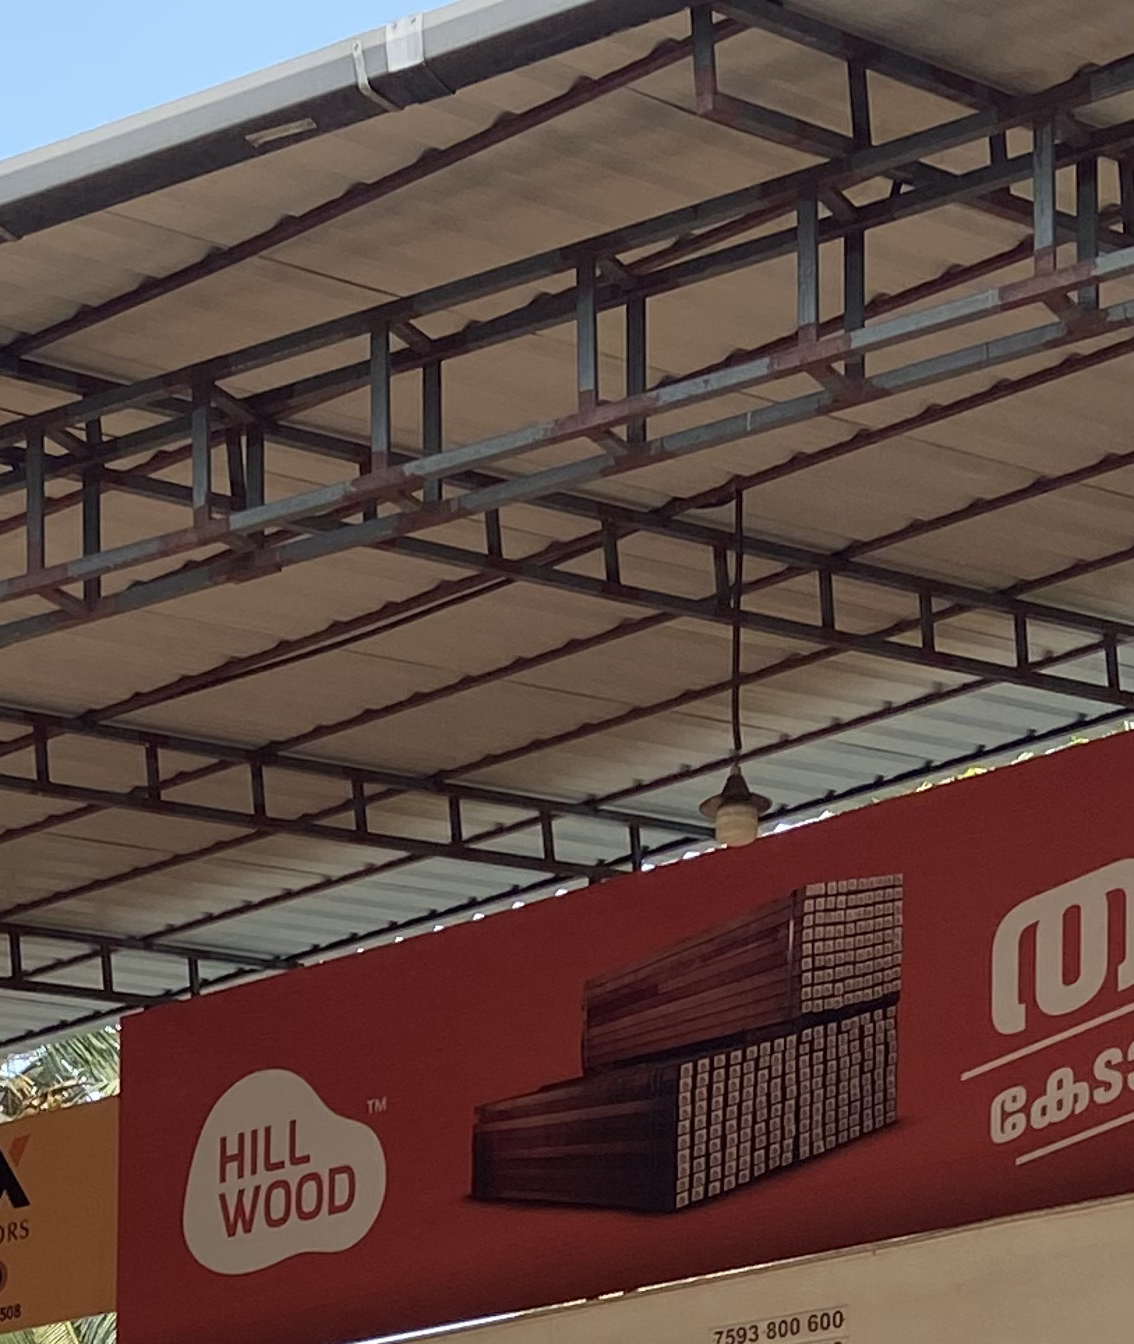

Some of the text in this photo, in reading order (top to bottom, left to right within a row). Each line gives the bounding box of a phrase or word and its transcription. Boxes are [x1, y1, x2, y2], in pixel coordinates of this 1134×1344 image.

[219, 1119, 310, 1183] HILL
[219, 1165, 356, 1238] WOOD
[766, 1317, 800, 1340] 800
[807, 1310, 843, 1332] 600
